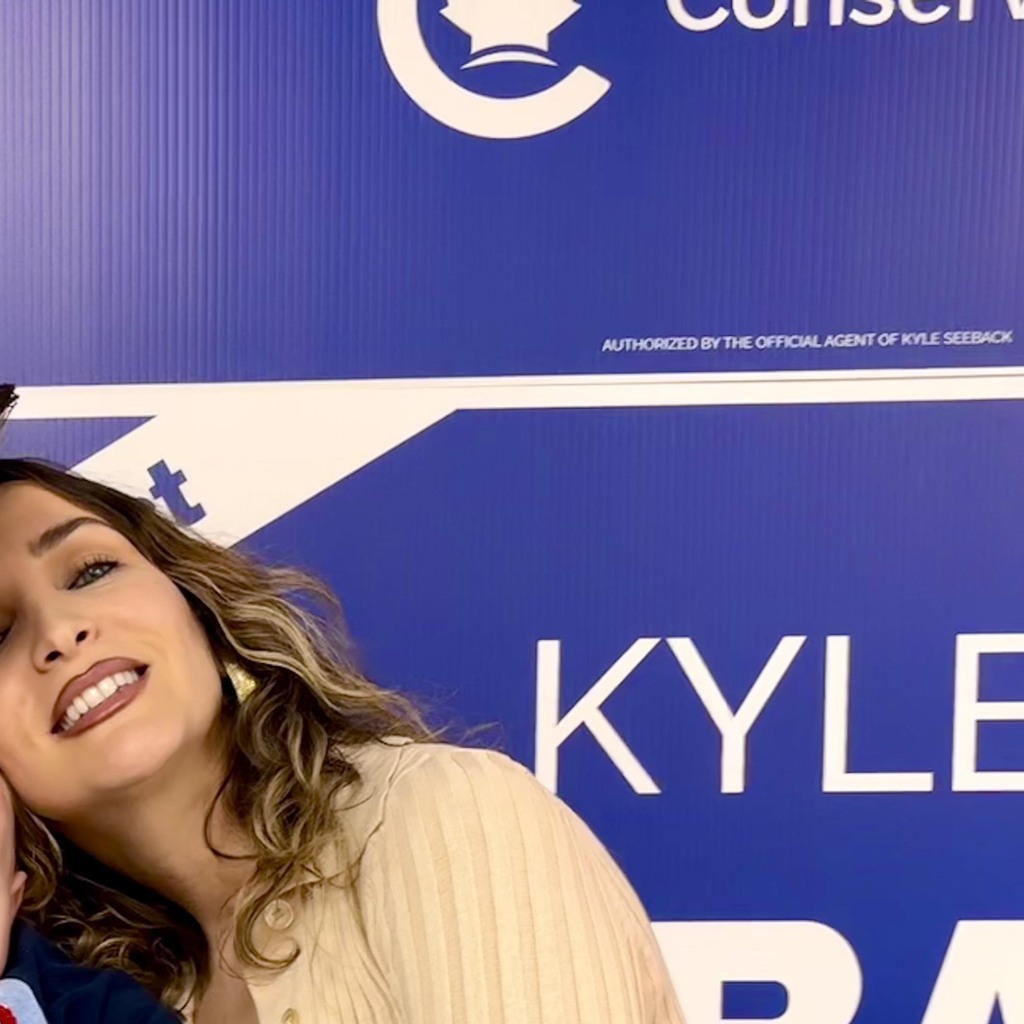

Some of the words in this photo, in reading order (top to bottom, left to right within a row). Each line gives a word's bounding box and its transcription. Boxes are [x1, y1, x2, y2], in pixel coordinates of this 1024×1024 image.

[601, 337, 699, 352] AUTHORIZED
[701, 335, 722, 350] BY
[723, 335, 754, 350] THE
[755, 334, 822, 349] OFFICIAL
[824, 333, 876, 348] AGENT
[877, 332, 899, 347] OF
[901, 331, 941, 346] KYLE
[943, 330, 1014, 345] SEEBACK
[535, 633, 1024, 794] KYLE
